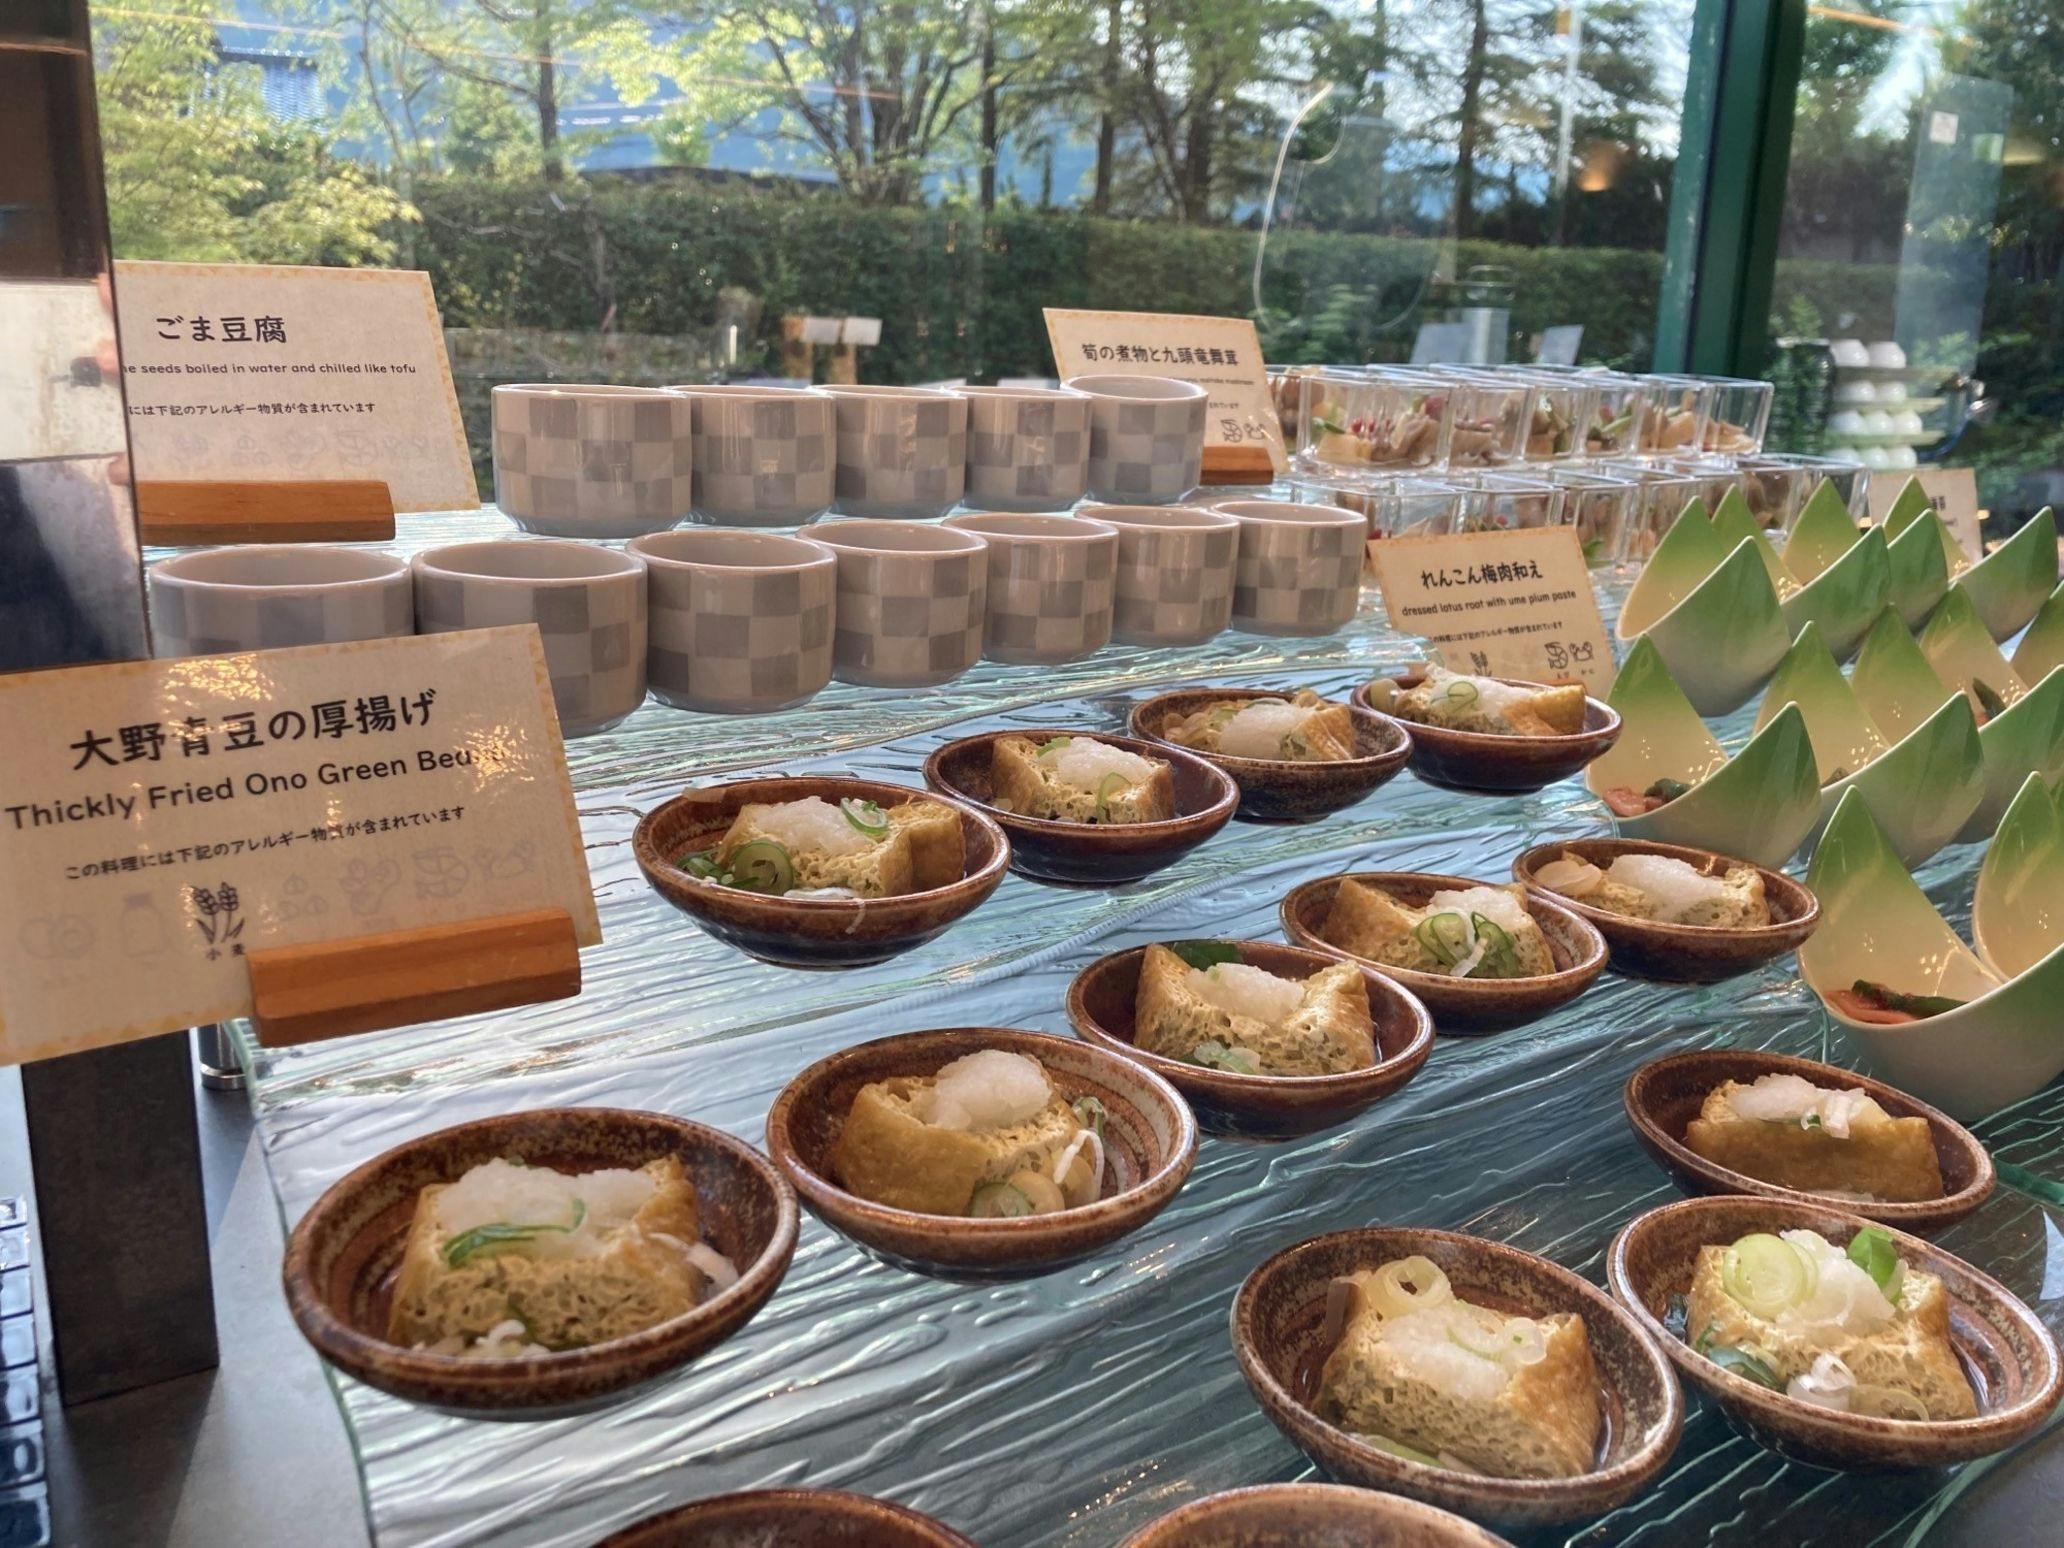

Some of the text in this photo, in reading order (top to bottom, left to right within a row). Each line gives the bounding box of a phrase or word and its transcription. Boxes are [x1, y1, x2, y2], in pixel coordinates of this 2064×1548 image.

[155, 315, 287, 344] ごま豆腐
[141, 363, 182, 374] seeds
[185, 363, 229, 374] boiled
[232, 363, 246, 374] in
[249, 363, 288, 374] water
[291, 363, 316, 374] and
[319, 363, 361, 374] chilled
[364, 363, 388, 374] like
[390, 363, 417, 375] tofu
[1081, 343, 1240, 367] 筍の煮物と九頭竜舞茸
[1420, 560, 1544, 590] れんこん梅肉和え
[1402, 589, 1577, 617] dressed lotus root with ume plum paste
[70, 688, 437, 771] 大野青豆の厚揚げ
[4, 746, 506, 830] Thickly Fried Ono Green Bea
